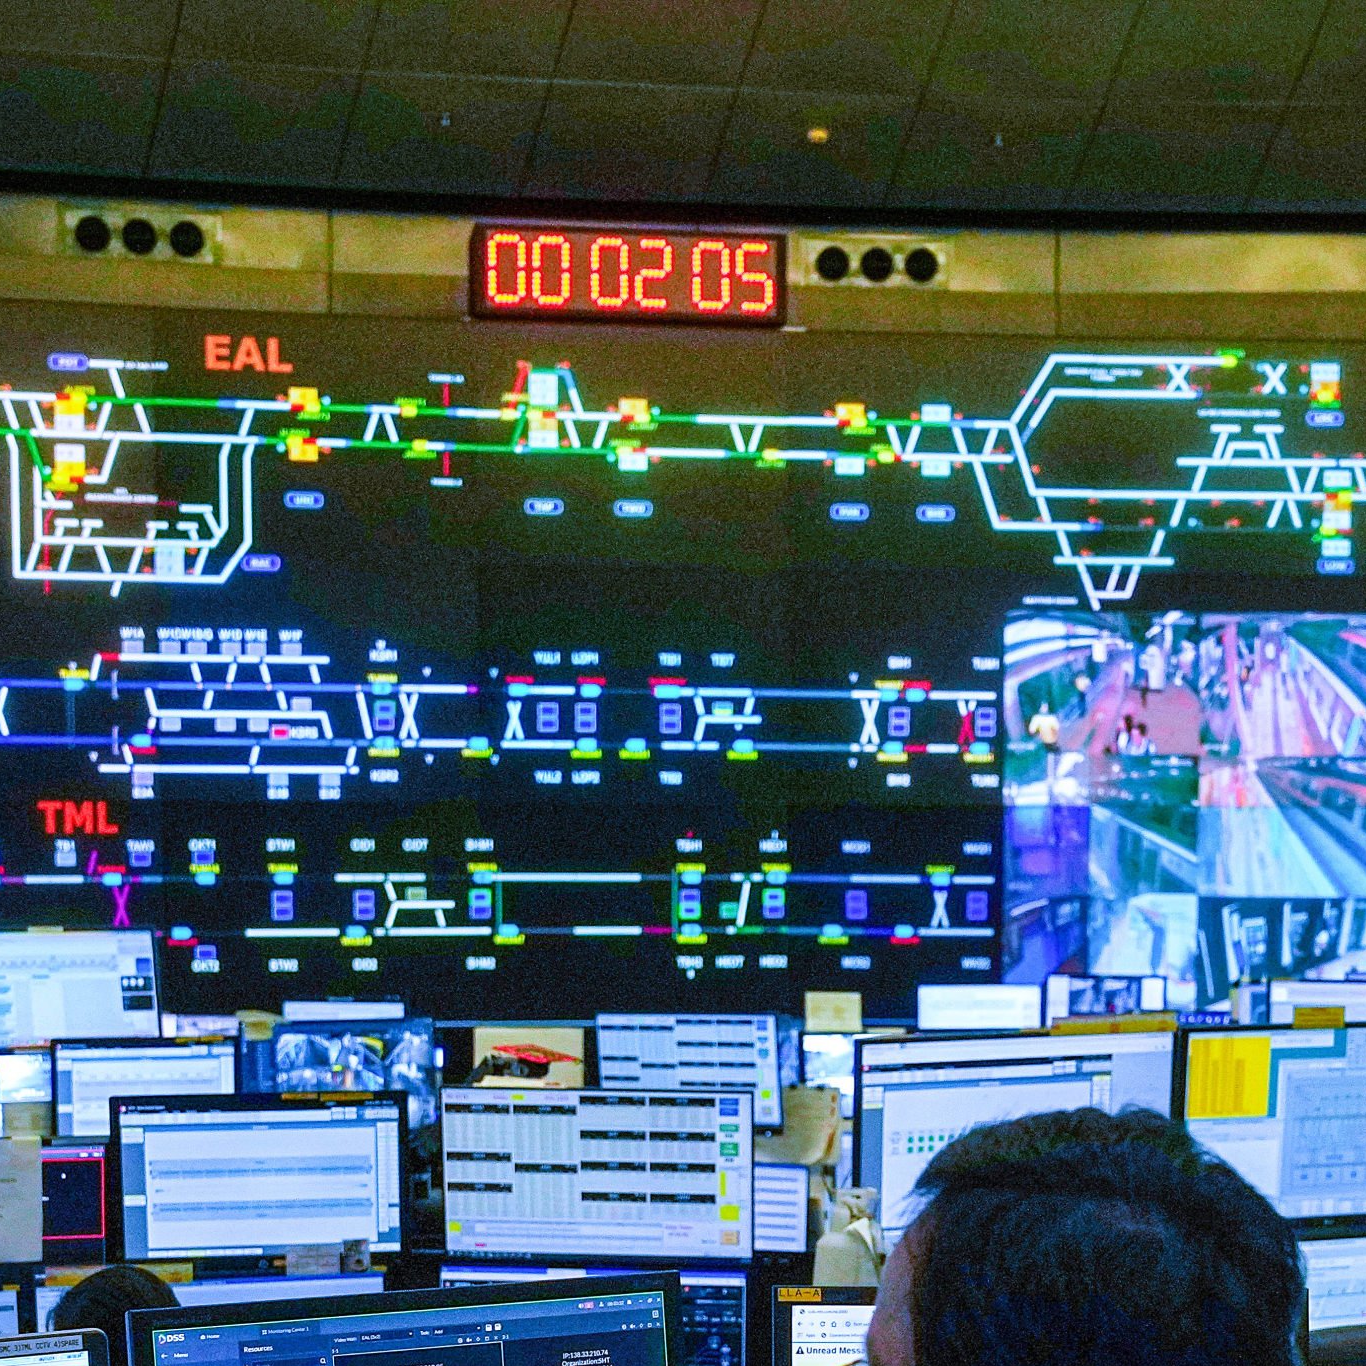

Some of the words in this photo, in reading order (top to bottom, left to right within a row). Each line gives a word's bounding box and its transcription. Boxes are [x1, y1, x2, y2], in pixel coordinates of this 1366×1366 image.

[486, 232, 571, 306] 00
[590, 235, 673, 310] 02
[692, 240, 774, 313] 05
[203, 334, 294, 374] EAL
[36, 800, 119, 834] TML
[779, 1289, 820, 1297] LLA-A
[167, 1334, 185, 1342] DSS
[244, 1345, 273, 1353] Resources
